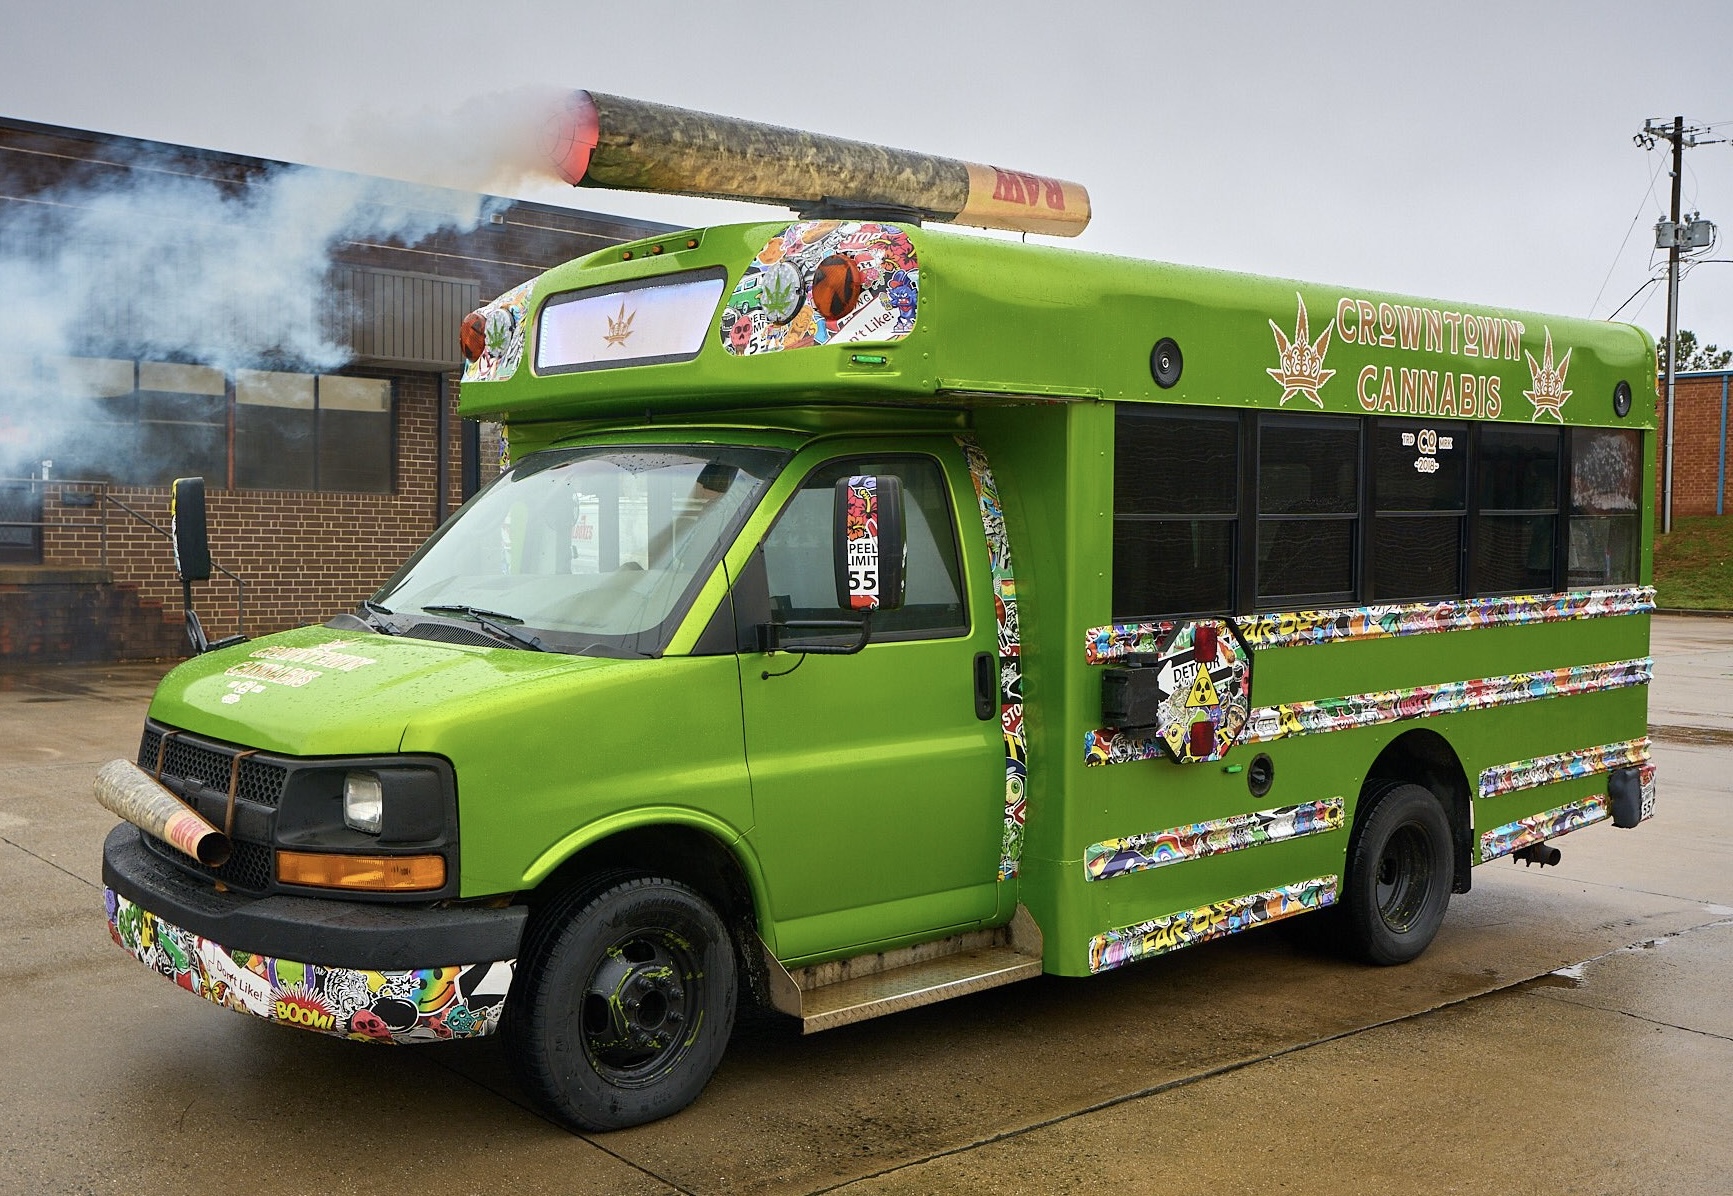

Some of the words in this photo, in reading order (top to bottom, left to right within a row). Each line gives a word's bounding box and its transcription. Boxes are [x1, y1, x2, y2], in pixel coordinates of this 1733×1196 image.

[865, 311, 894, 333] Like!
[1337, 298, 1521, 361] CROWNTOWN
[1357, 365, 1502, 419] CANNABIS
[849, 571, 876, 590] 55
[239, 979, 263, 1002] Like!
[275, 1001, 335, 1031] BOOM!
